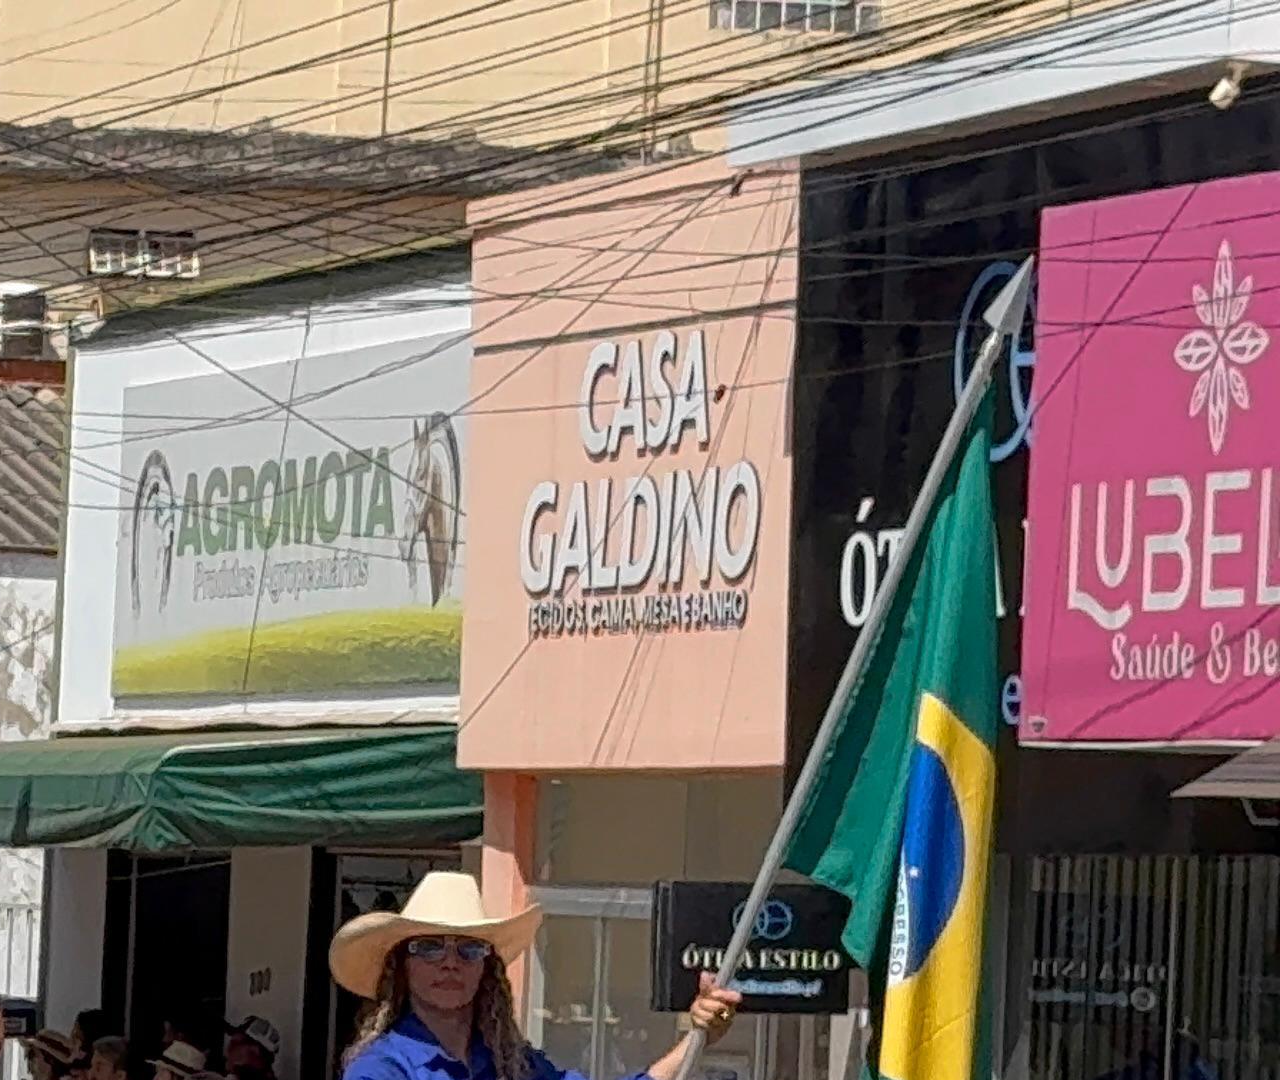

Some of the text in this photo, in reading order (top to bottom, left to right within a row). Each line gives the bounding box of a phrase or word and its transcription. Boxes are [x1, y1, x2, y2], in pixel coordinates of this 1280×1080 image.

[578, 328, 710, 461] CASA
[177, 447, 395, 557] AGROMOTA
[520, 460, 761, 598] GALDINO
[1067, 467, 1280, 630] LUBEL
[643, 594, 680, 633] MESA
[693, 588, 748, 631] BANHO
[1110, 630, 1195, 681] Saúde
[1207, 621, 1232, 685] &
[681, 942, 841, 971] ÓTIA ESTILO
